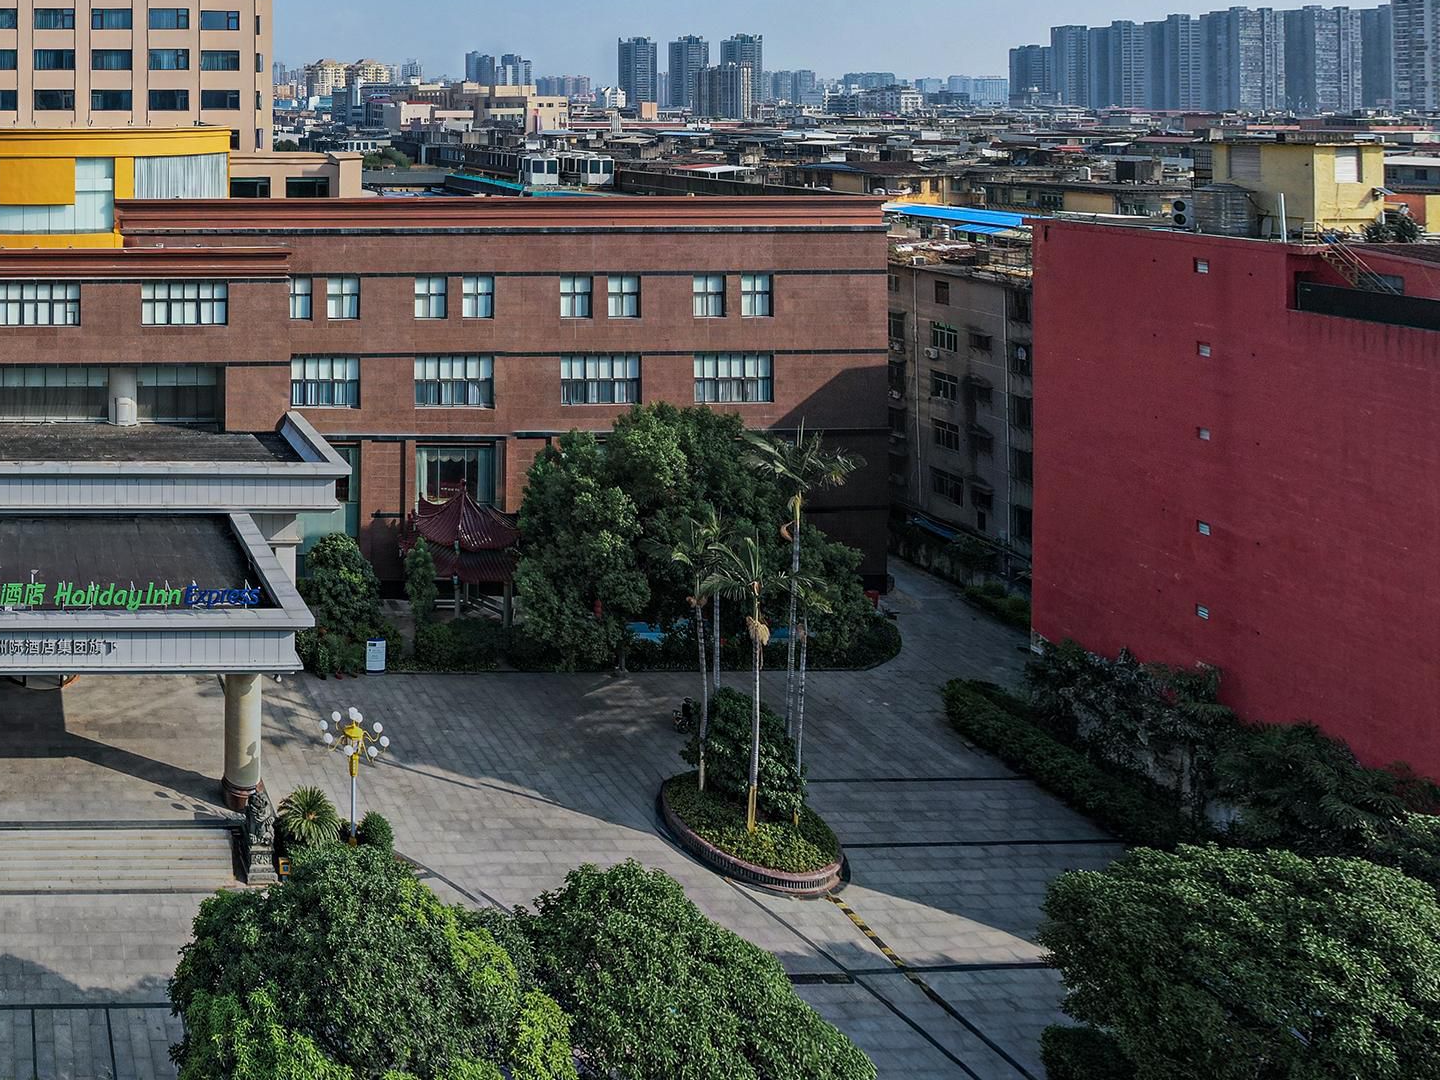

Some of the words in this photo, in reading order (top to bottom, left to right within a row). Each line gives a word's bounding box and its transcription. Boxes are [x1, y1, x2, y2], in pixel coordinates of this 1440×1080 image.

[53, 580, 142, 610] Holiday
[145, 581, 182, 606] Inn
[184, 585, 260, 608] Express
